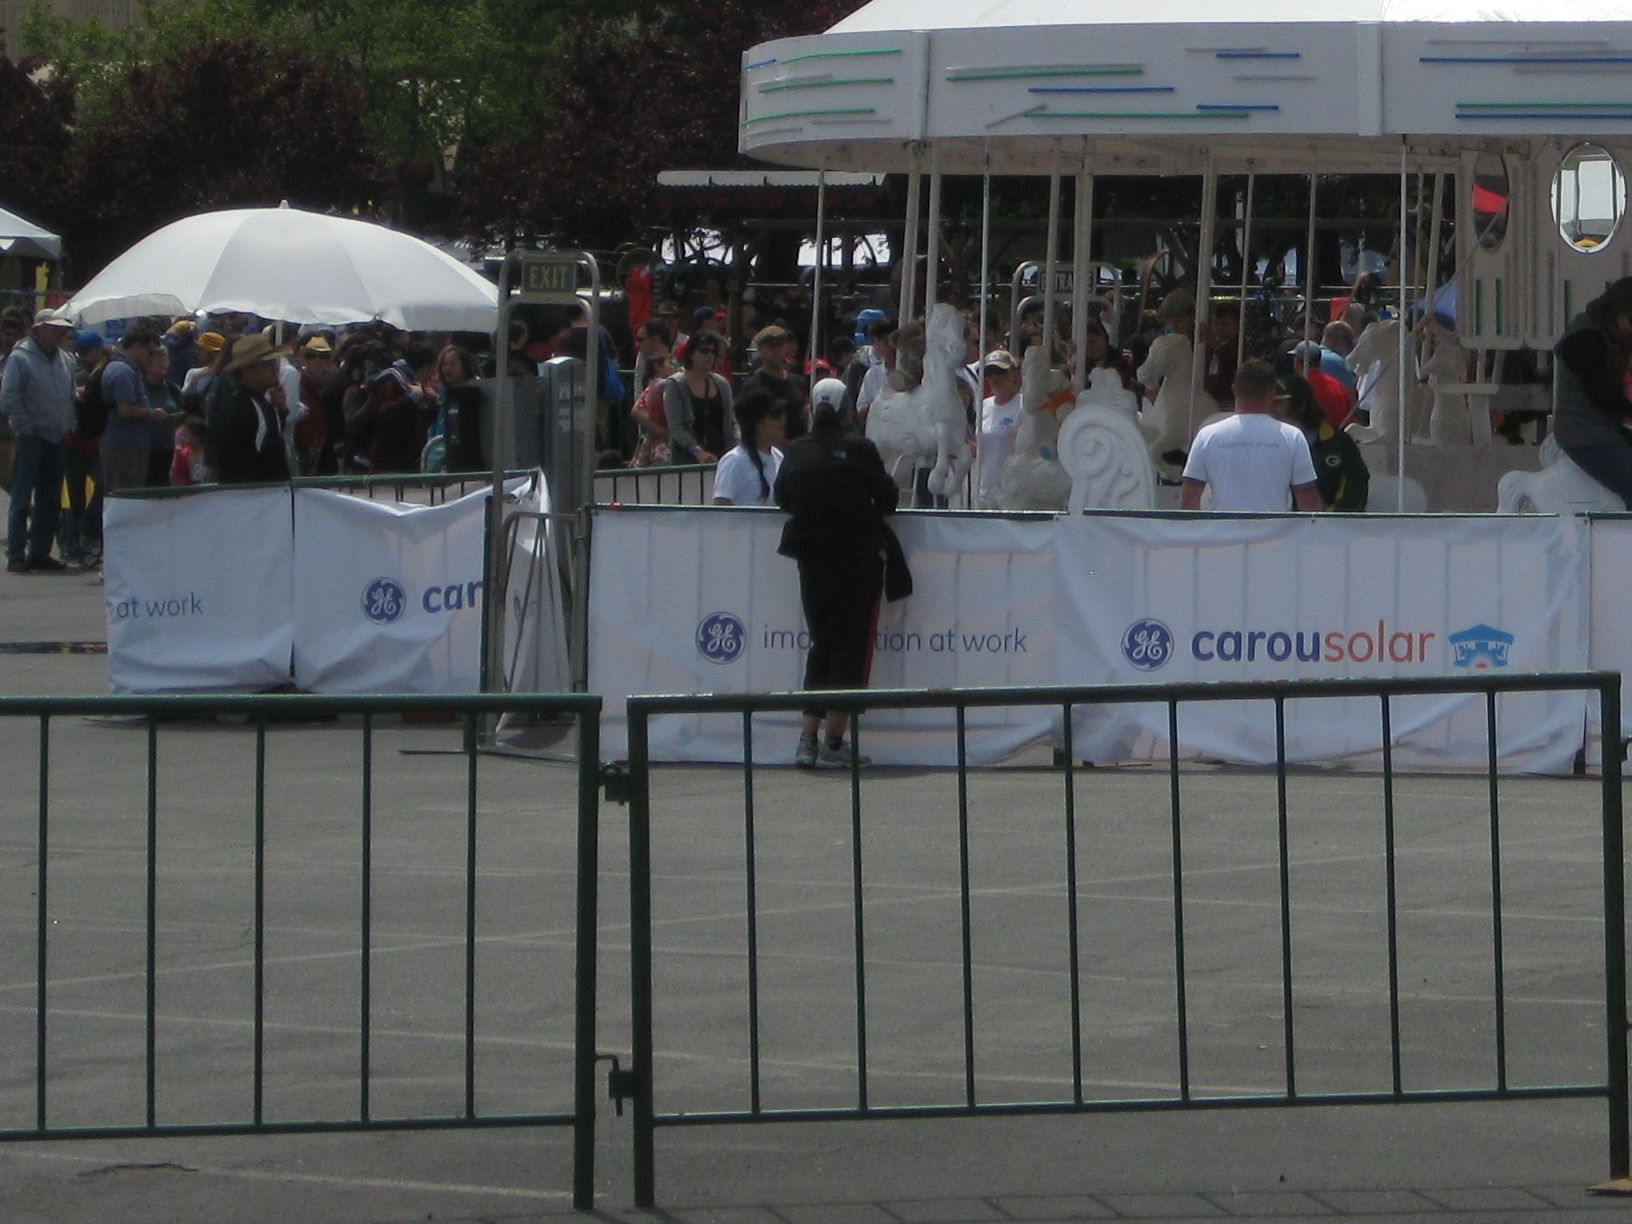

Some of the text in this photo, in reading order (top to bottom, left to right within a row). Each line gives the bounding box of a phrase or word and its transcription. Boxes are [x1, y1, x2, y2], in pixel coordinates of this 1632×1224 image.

[529, 265, 568, 289] EXIT
[117, 591, 203, 619] at work
[929, 628, 955, 653] at
[962, 627, 1027, 653] work
[1191, 618, 1435, 664] carousolar
